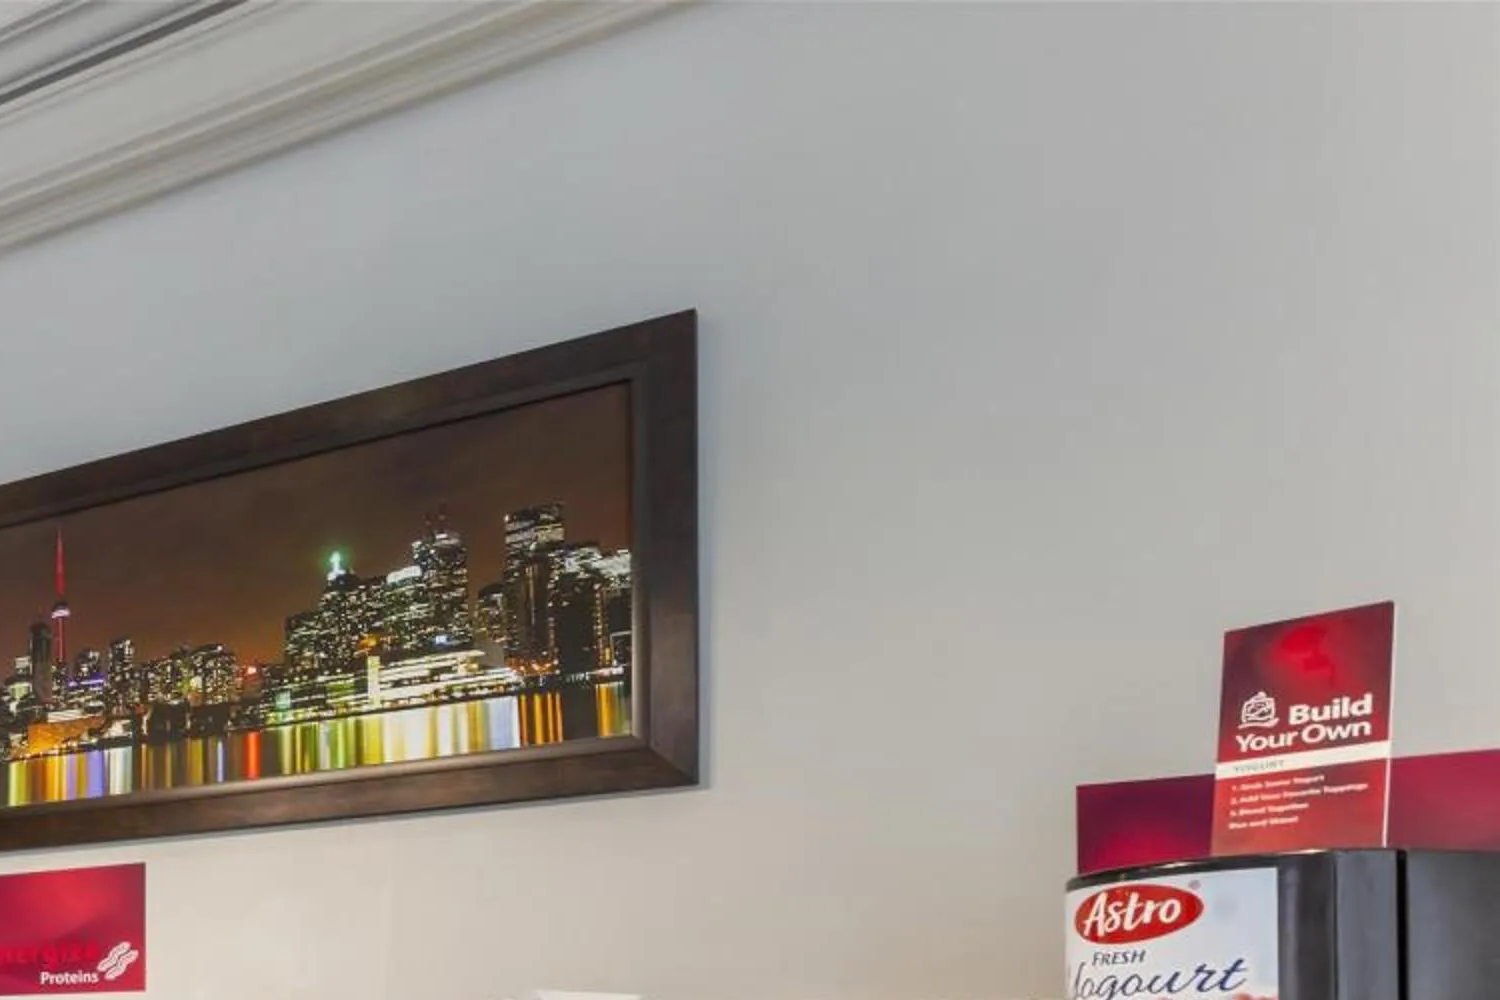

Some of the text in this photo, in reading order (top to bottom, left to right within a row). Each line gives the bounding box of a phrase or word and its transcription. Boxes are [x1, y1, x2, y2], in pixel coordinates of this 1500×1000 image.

[1288, 692, 1373, 725] Build
[1235, 720, 1372, 753] Your Own
[1083, 891, 1182, 938] Astro
[1092, 950, 1146, 966] FRESH
[40, 969, 100, 985] Proteins
